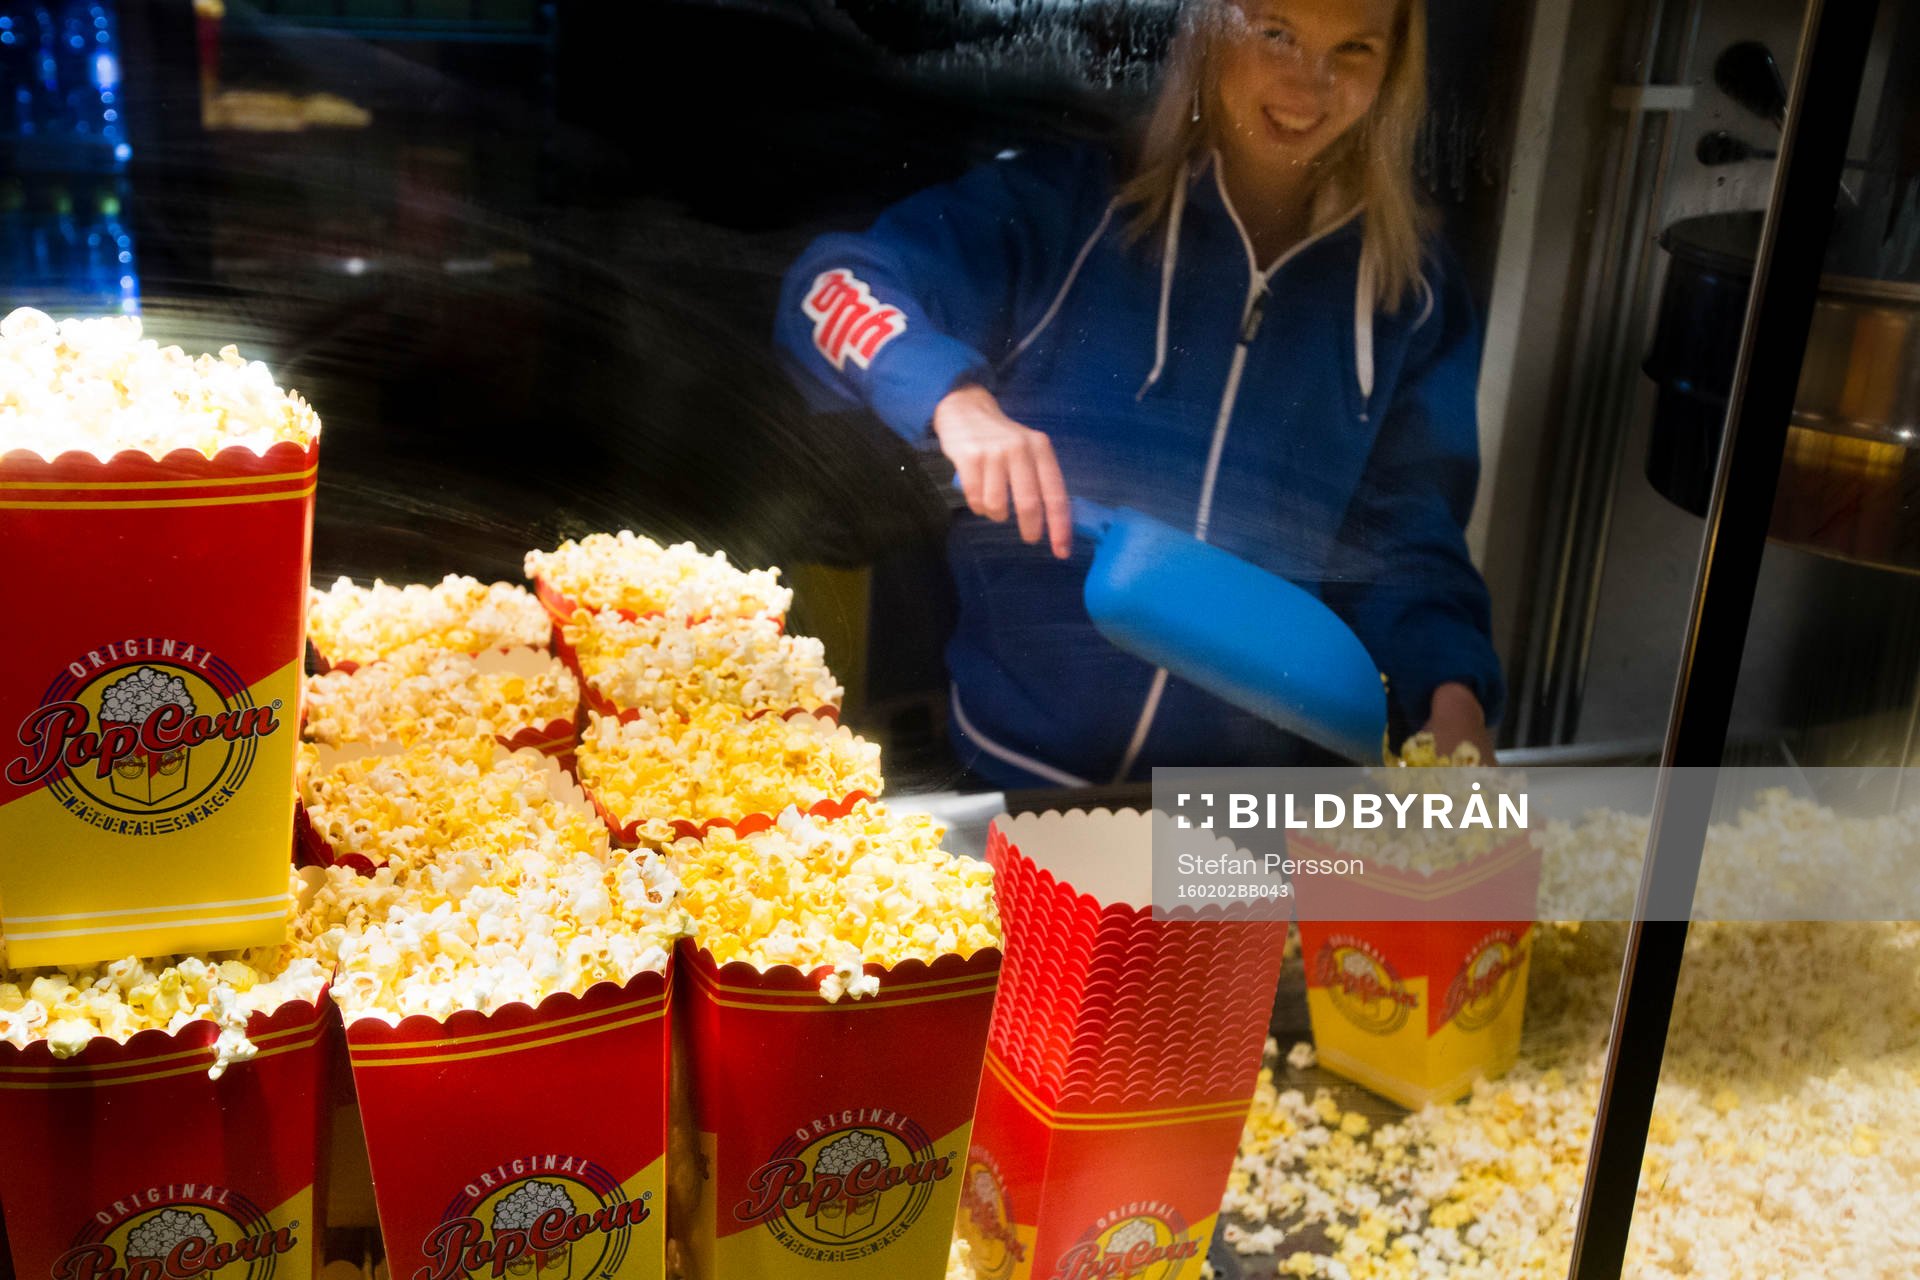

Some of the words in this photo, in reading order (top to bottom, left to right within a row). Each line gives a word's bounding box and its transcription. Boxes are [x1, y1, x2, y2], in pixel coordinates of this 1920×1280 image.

[69, 637, 213, 679] ORIGINAL
[62, 794, 158, 836] NATURAL
[173, 784, 237, 831] SNACK
[796, 1108, 908, 1141] ORIGINAL
[464, 1154, 588, 1198] ORIGINAL
[96, 1183, 229, 1226] ORIGINAL
[1096, 1200, 1174, 1230] ORIGINAL
[774, 1229, 847, 1262] NATURAL
[860, 1222, 912, 1257] SNACK
